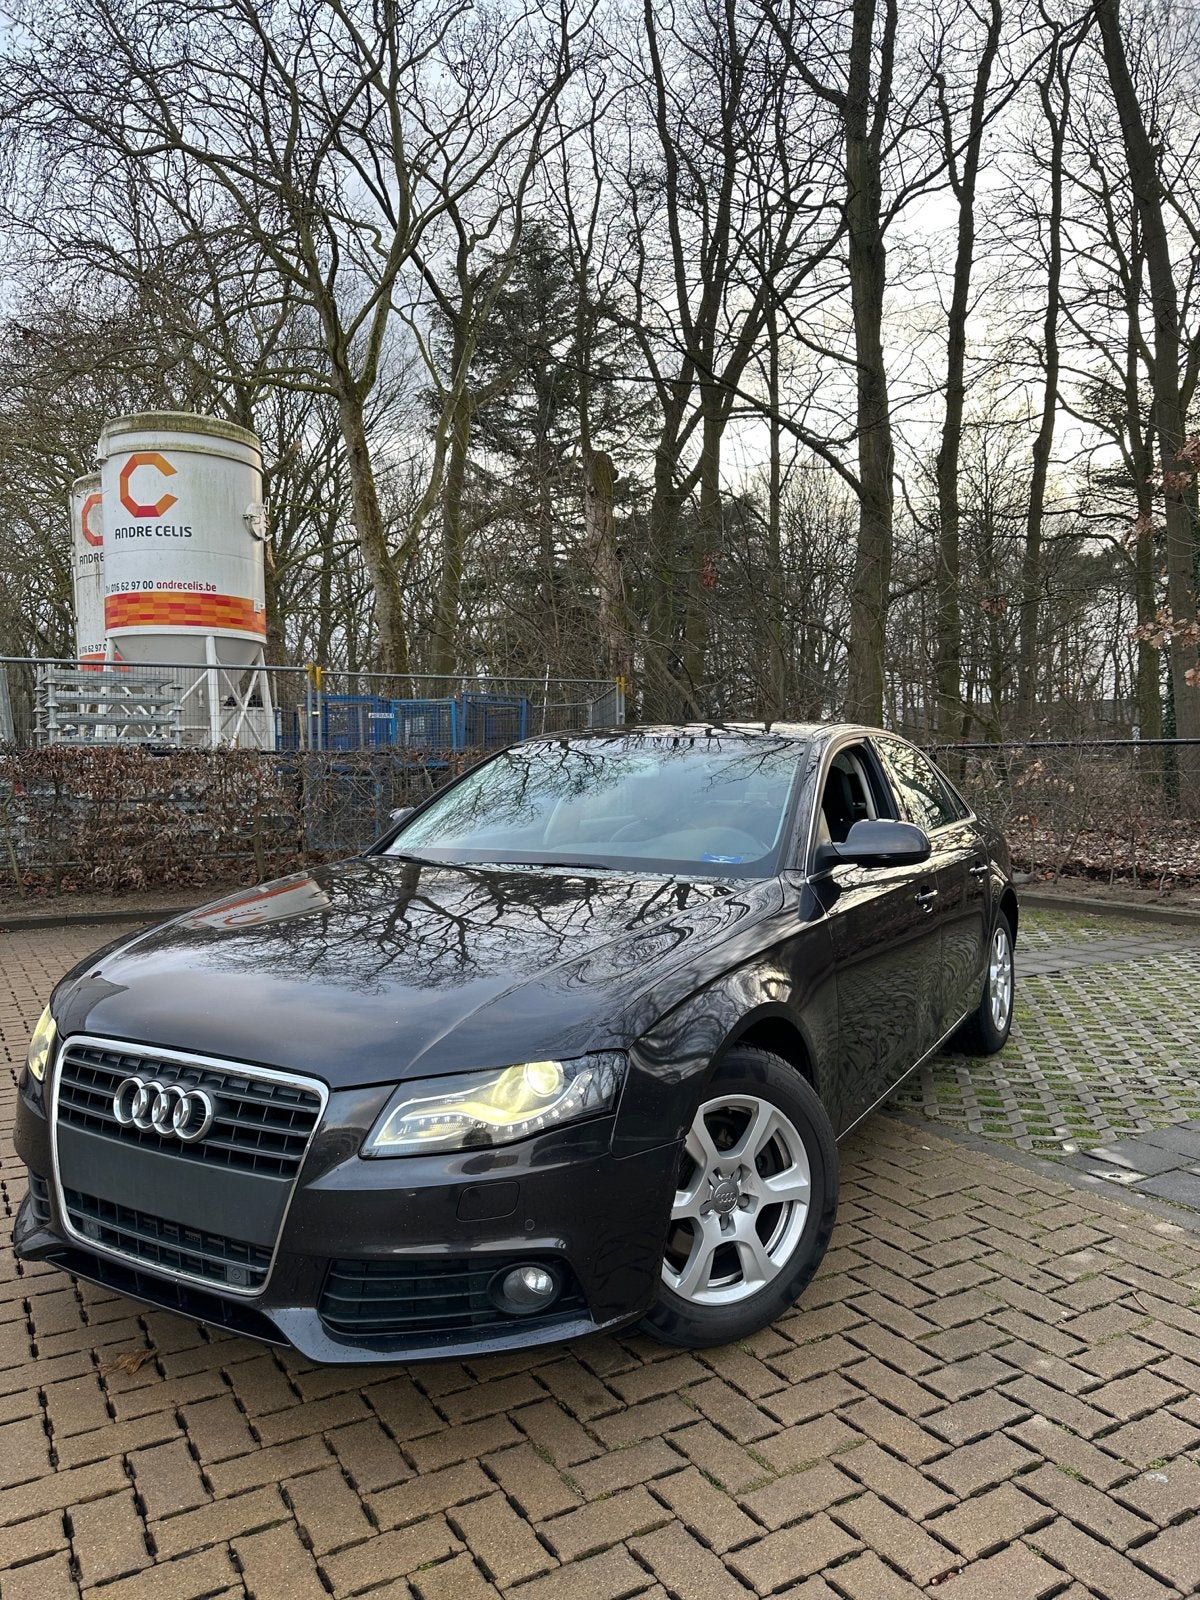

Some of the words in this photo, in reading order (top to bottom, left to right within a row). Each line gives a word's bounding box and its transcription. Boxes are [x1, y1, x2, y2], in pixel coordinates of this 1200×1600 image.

[115, 526, 152, 540] ANDRE
[155, 525, 193, 538] CELIS
[80, 552, 104, 565] ANDRE
[121, 581, 129, 591] 62
[131, 580, 140, 590] 97
[142, 580, 154, 590] 00
[156, 580, 217, 592] andrecelis.be
[95, 644, 102, 652] 97
